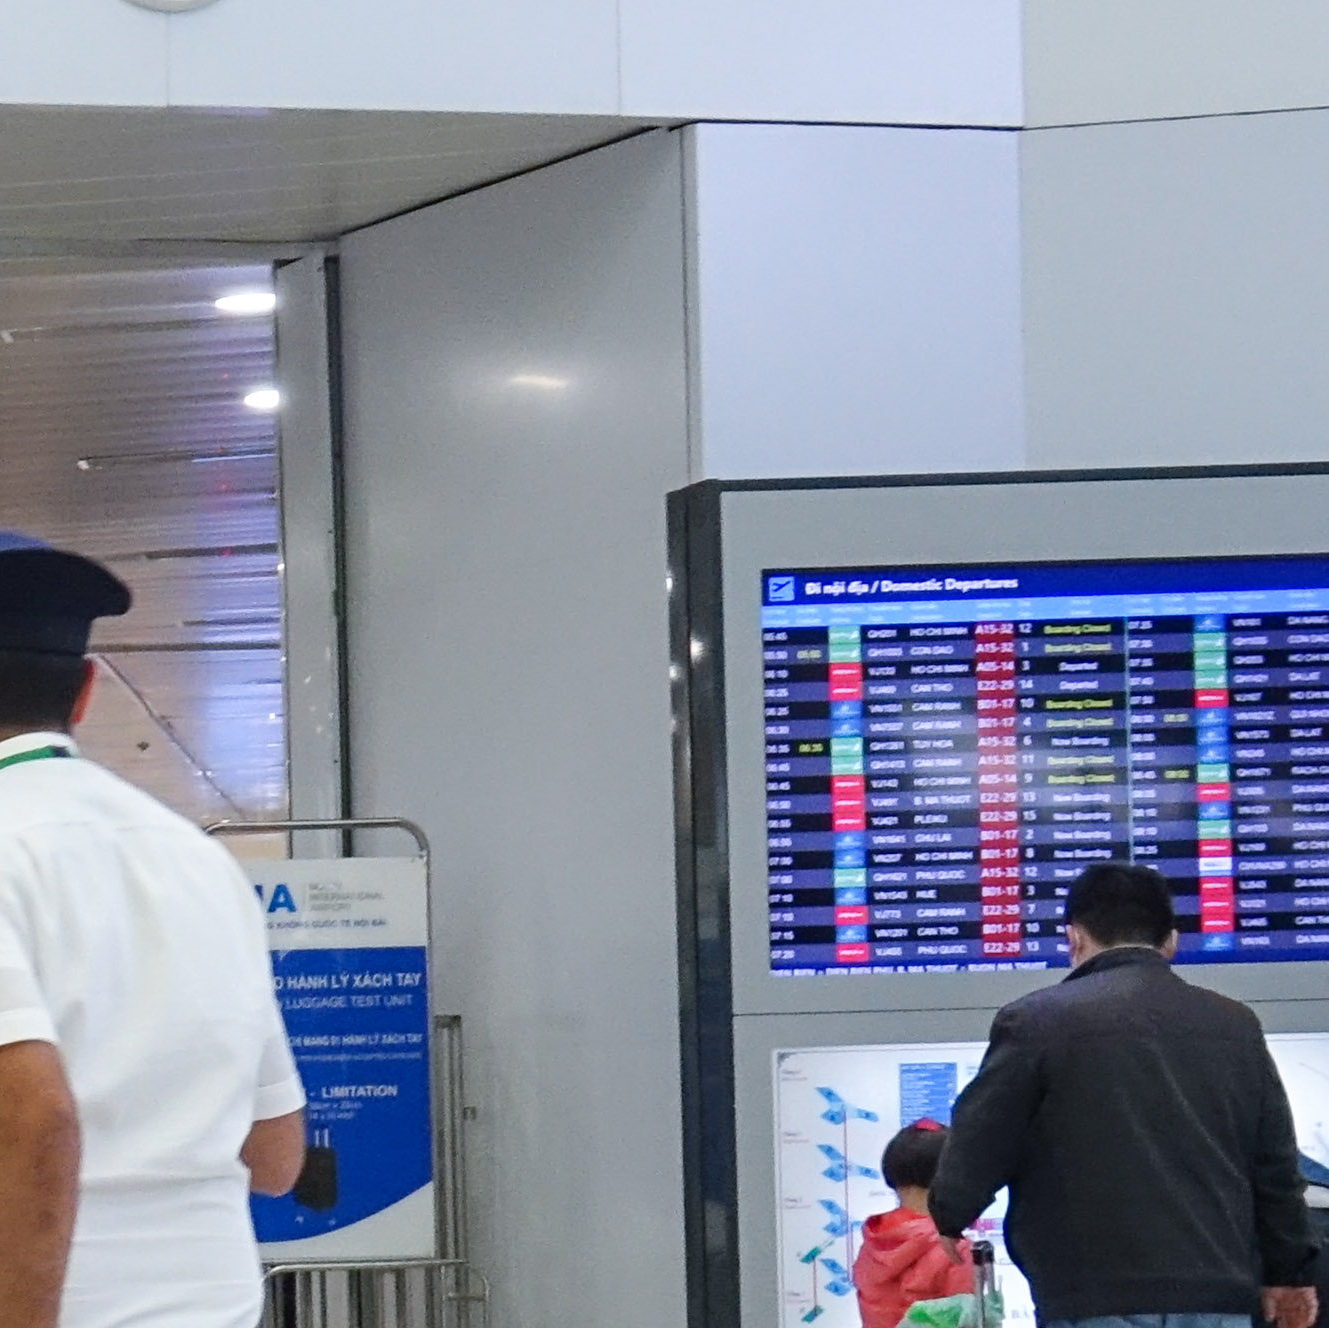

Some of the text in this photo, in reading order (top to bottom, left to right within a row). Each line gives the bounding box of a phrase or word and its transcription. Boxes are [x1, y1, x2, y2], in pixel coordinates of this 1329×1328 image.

[881, 579, 943, 592] Domestic
[945, 579, 1018, 592] Departures
[1019, 622, 1031, 633] 12
[1027, 828, 1034, 839] 2
[287, 973, 327, 989] HÀNH
[352, 970, 392, 988] XÁCH
[396, 972, 422, 986] TAY
[286, 996, 347, 1009] LUGGAGE
[350, 994, 381, 1007] TEST
[384, 994, 413, 1006] UNIT
[322, 1085, 397, 1098] LIMITATION
